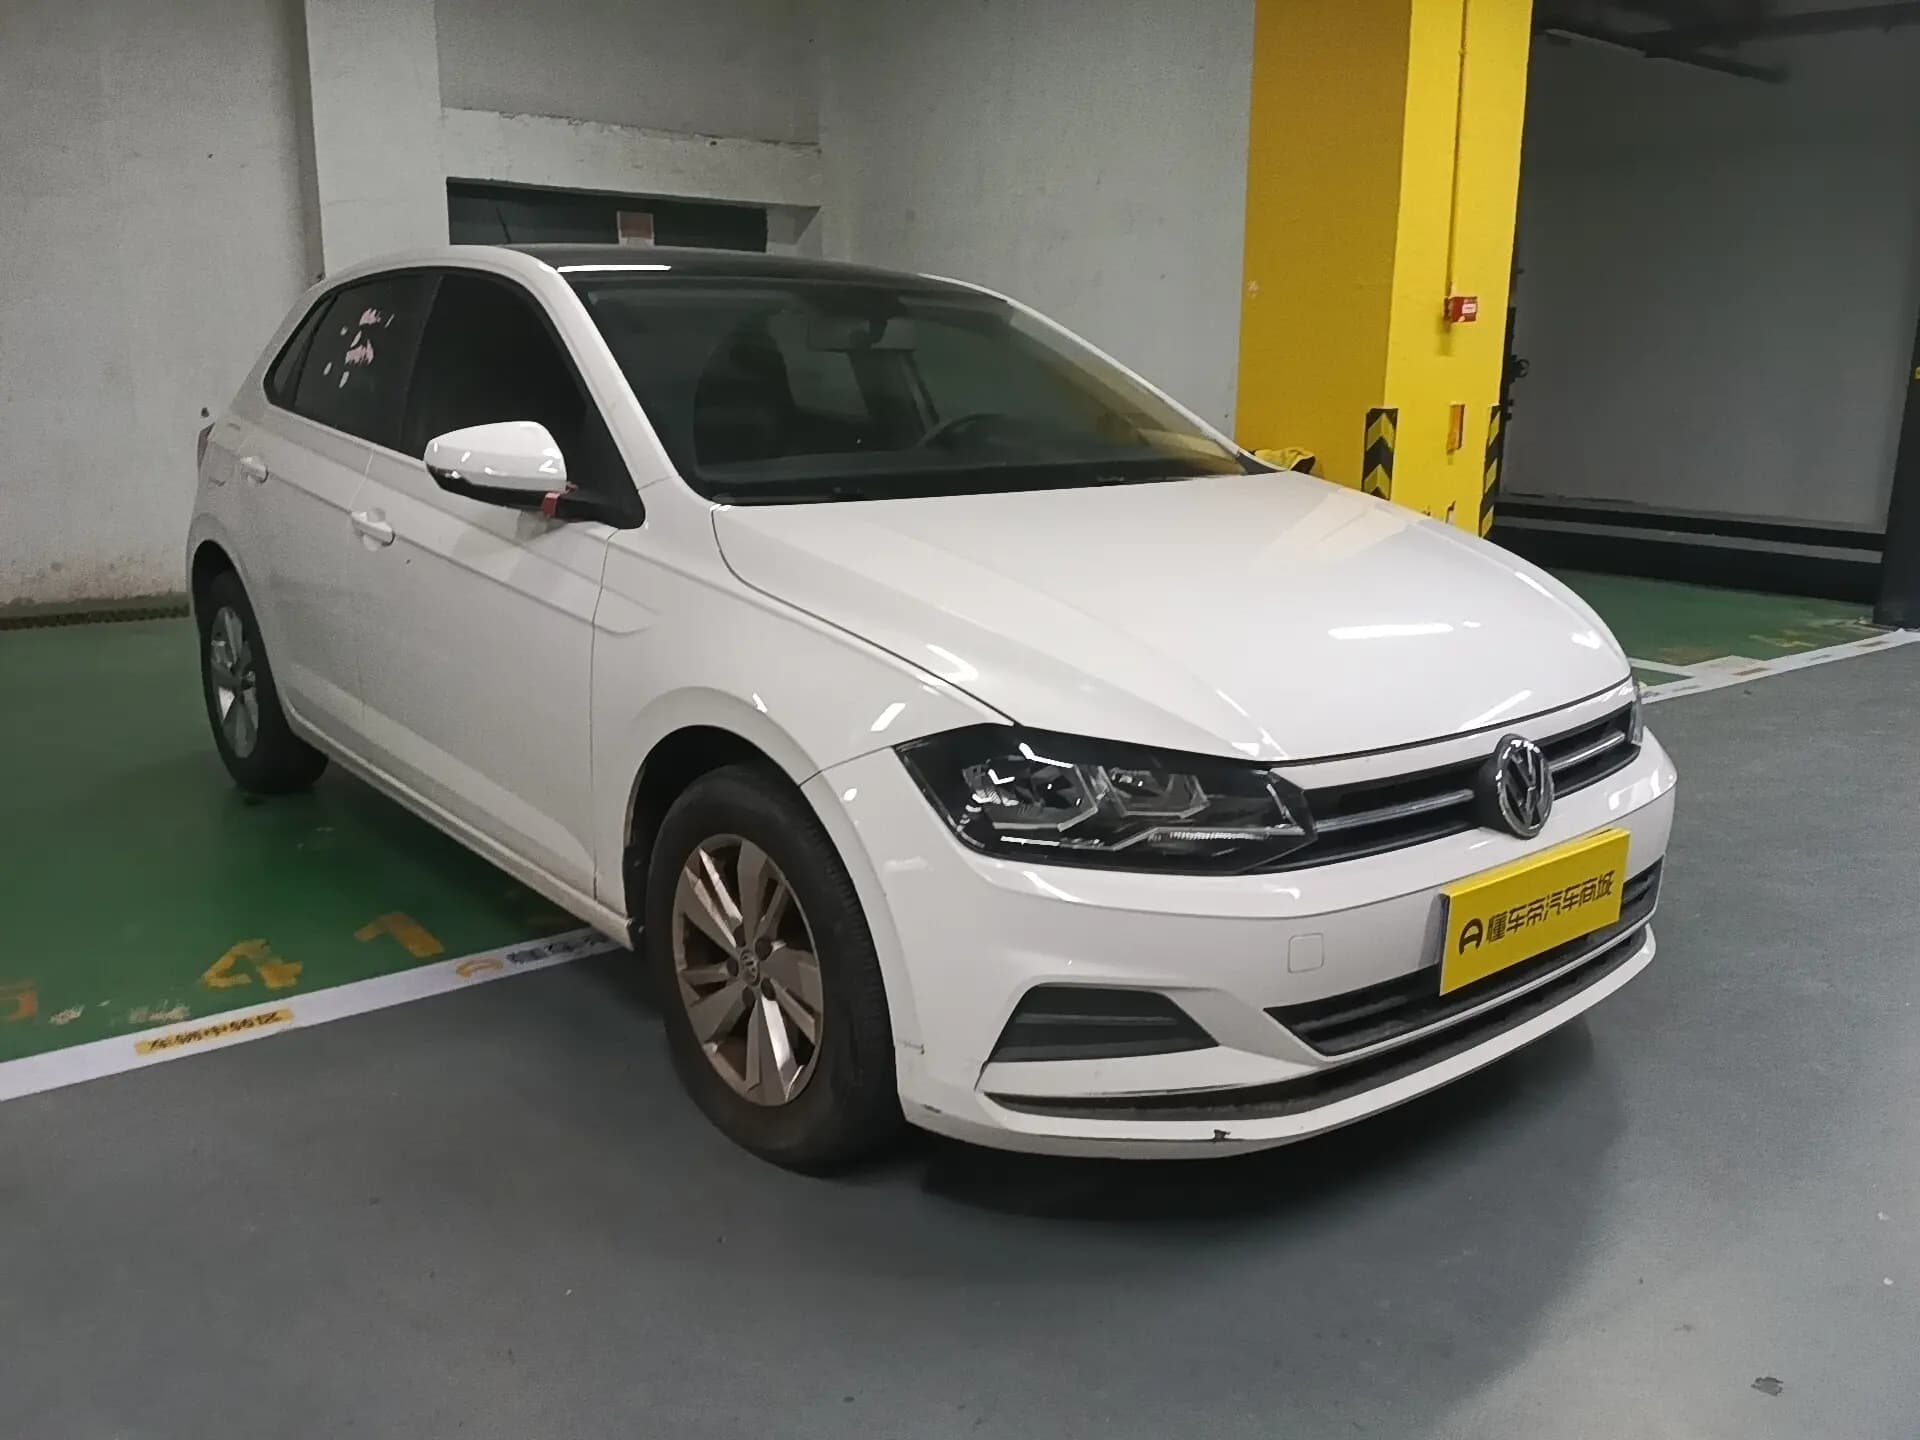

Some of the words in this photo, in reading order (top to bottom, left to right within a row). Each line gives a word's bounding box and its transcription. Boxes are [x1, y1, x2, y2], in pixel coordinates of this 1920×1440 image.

[1486, 869, 1616, 944] 懂车帝汽车商城
